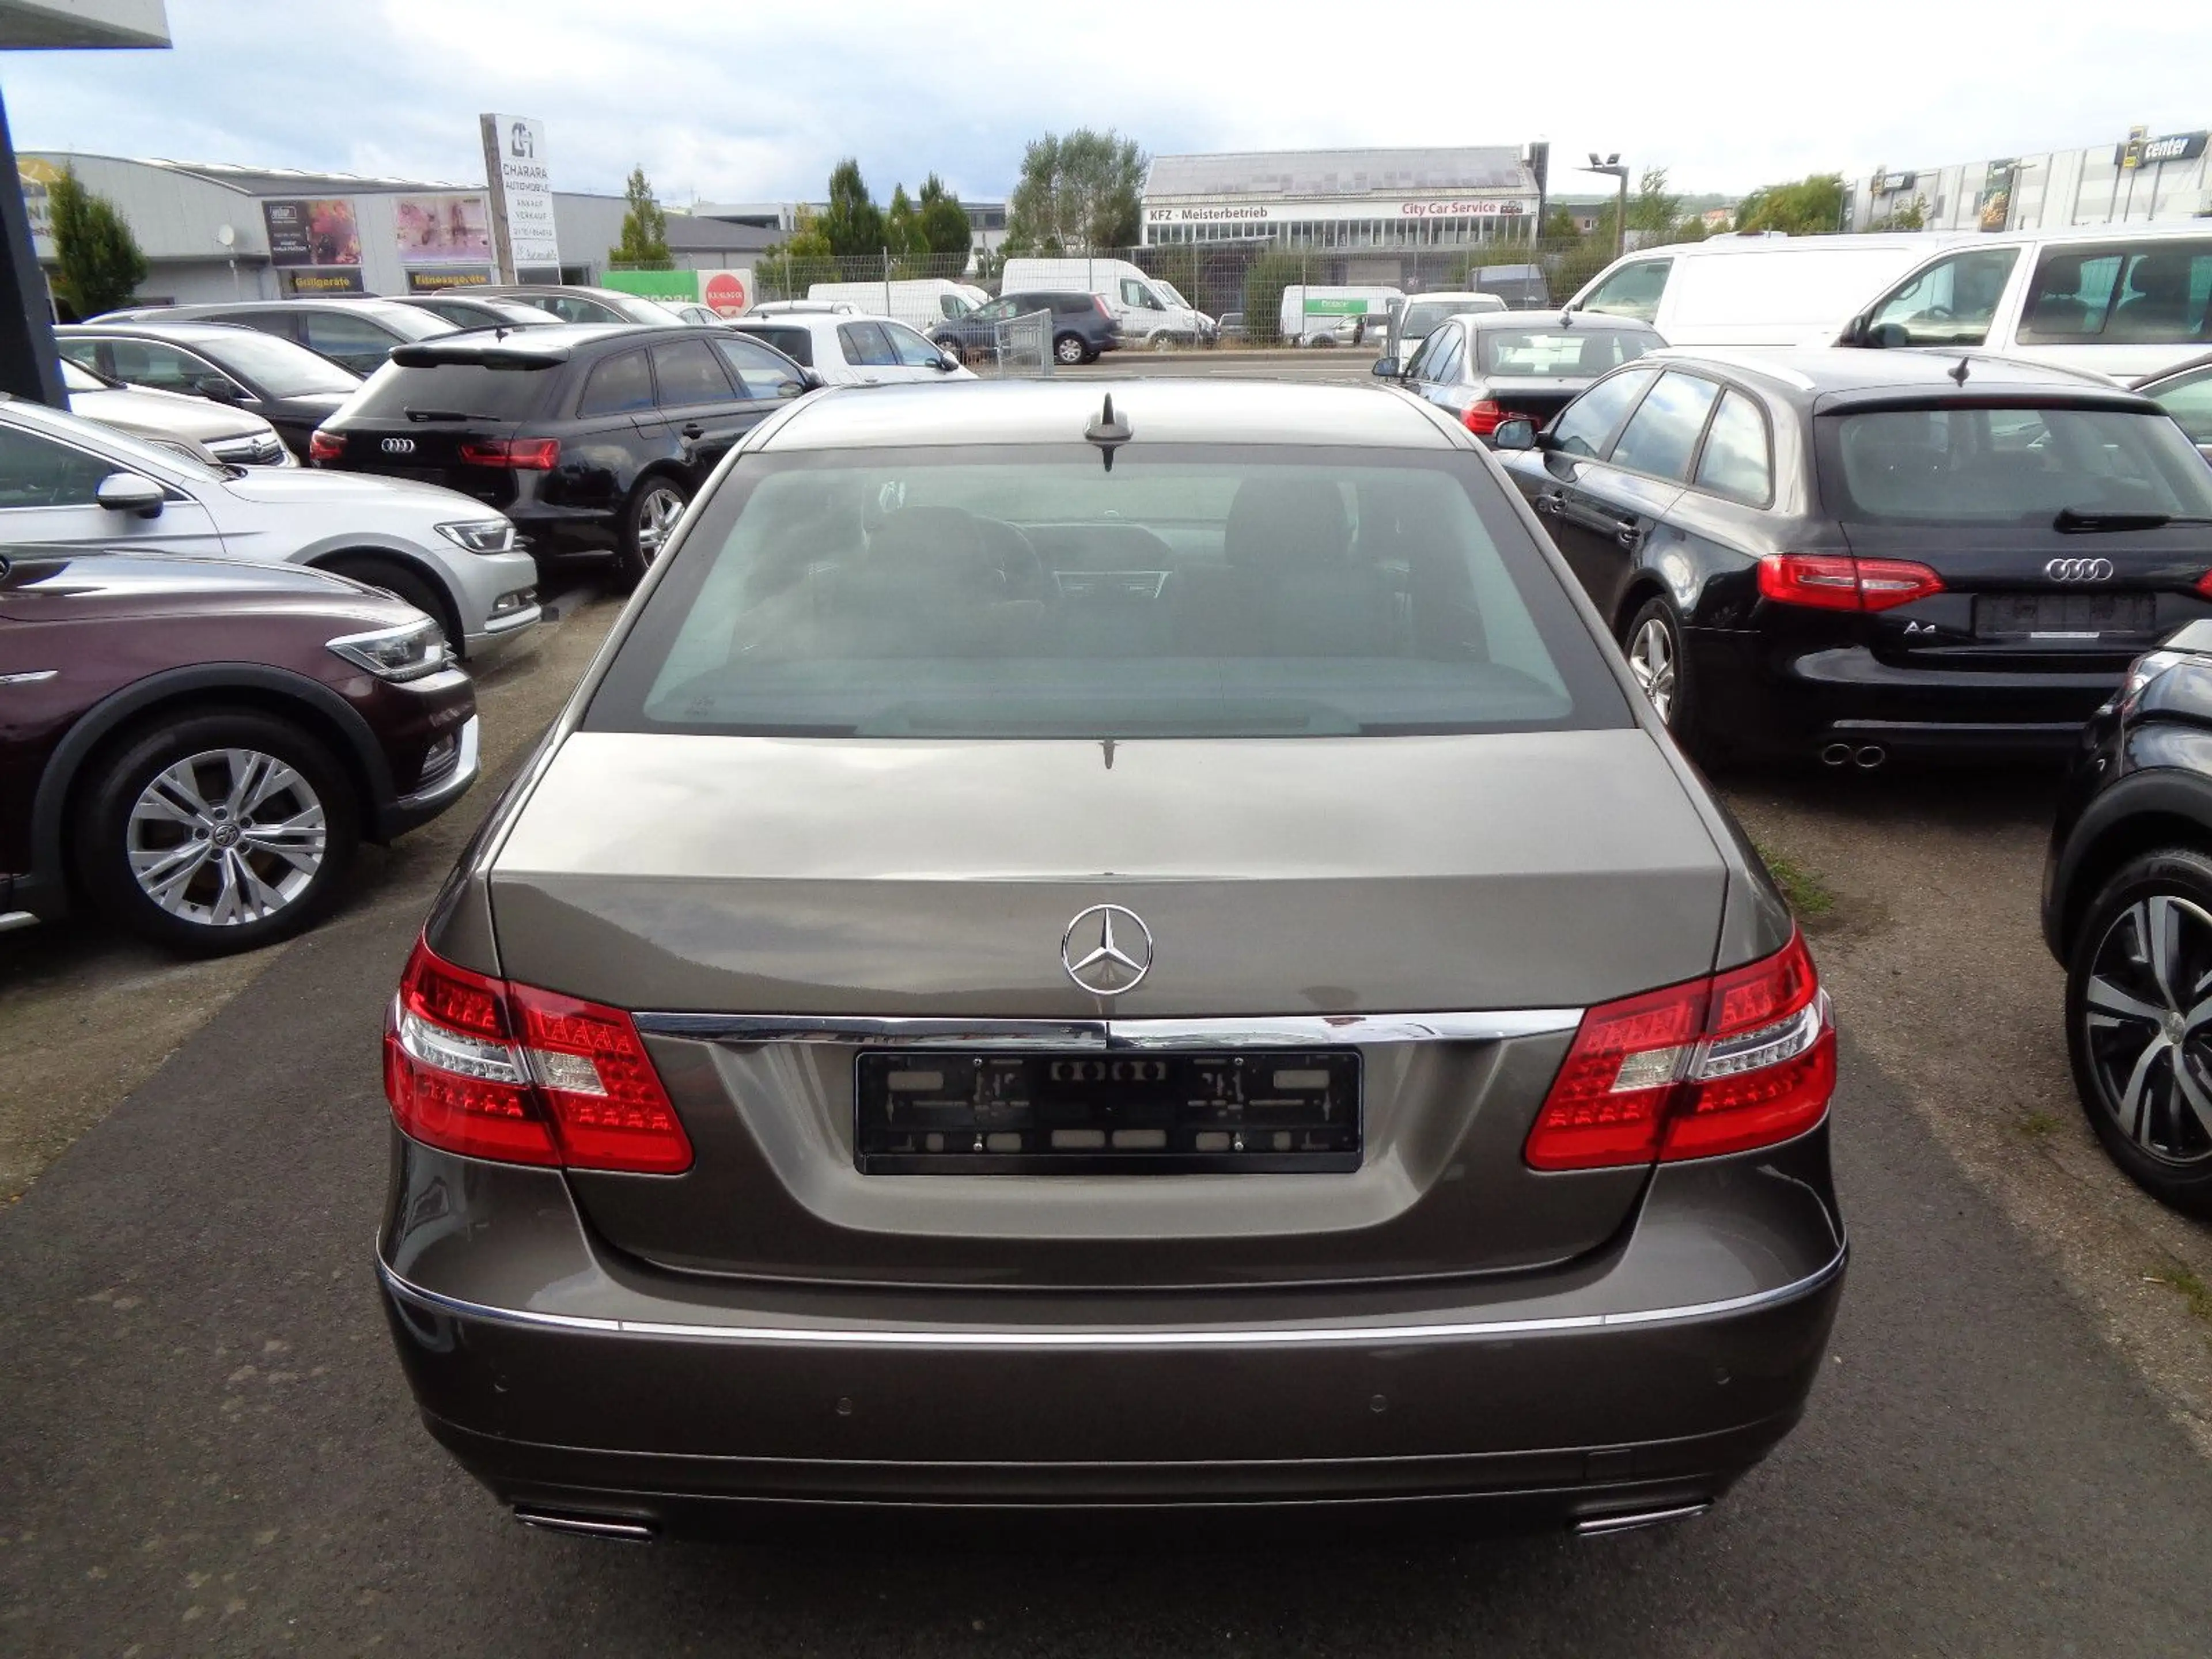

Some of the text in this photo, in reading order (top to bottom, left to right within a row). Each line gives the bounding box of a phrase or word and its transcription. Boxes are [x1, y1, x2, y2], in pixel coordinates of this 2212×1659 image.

[2146, 137, 2189, 158] center
[503, 163, 548, 179] CHARARA
[1150, 210, 1172, 221] KFZ
[1181, 206, 1267, 220] Meisterbetrieb
[1402, 202, 1496, 216] City Car Service
[1903, 621, 1937, 634] A4
